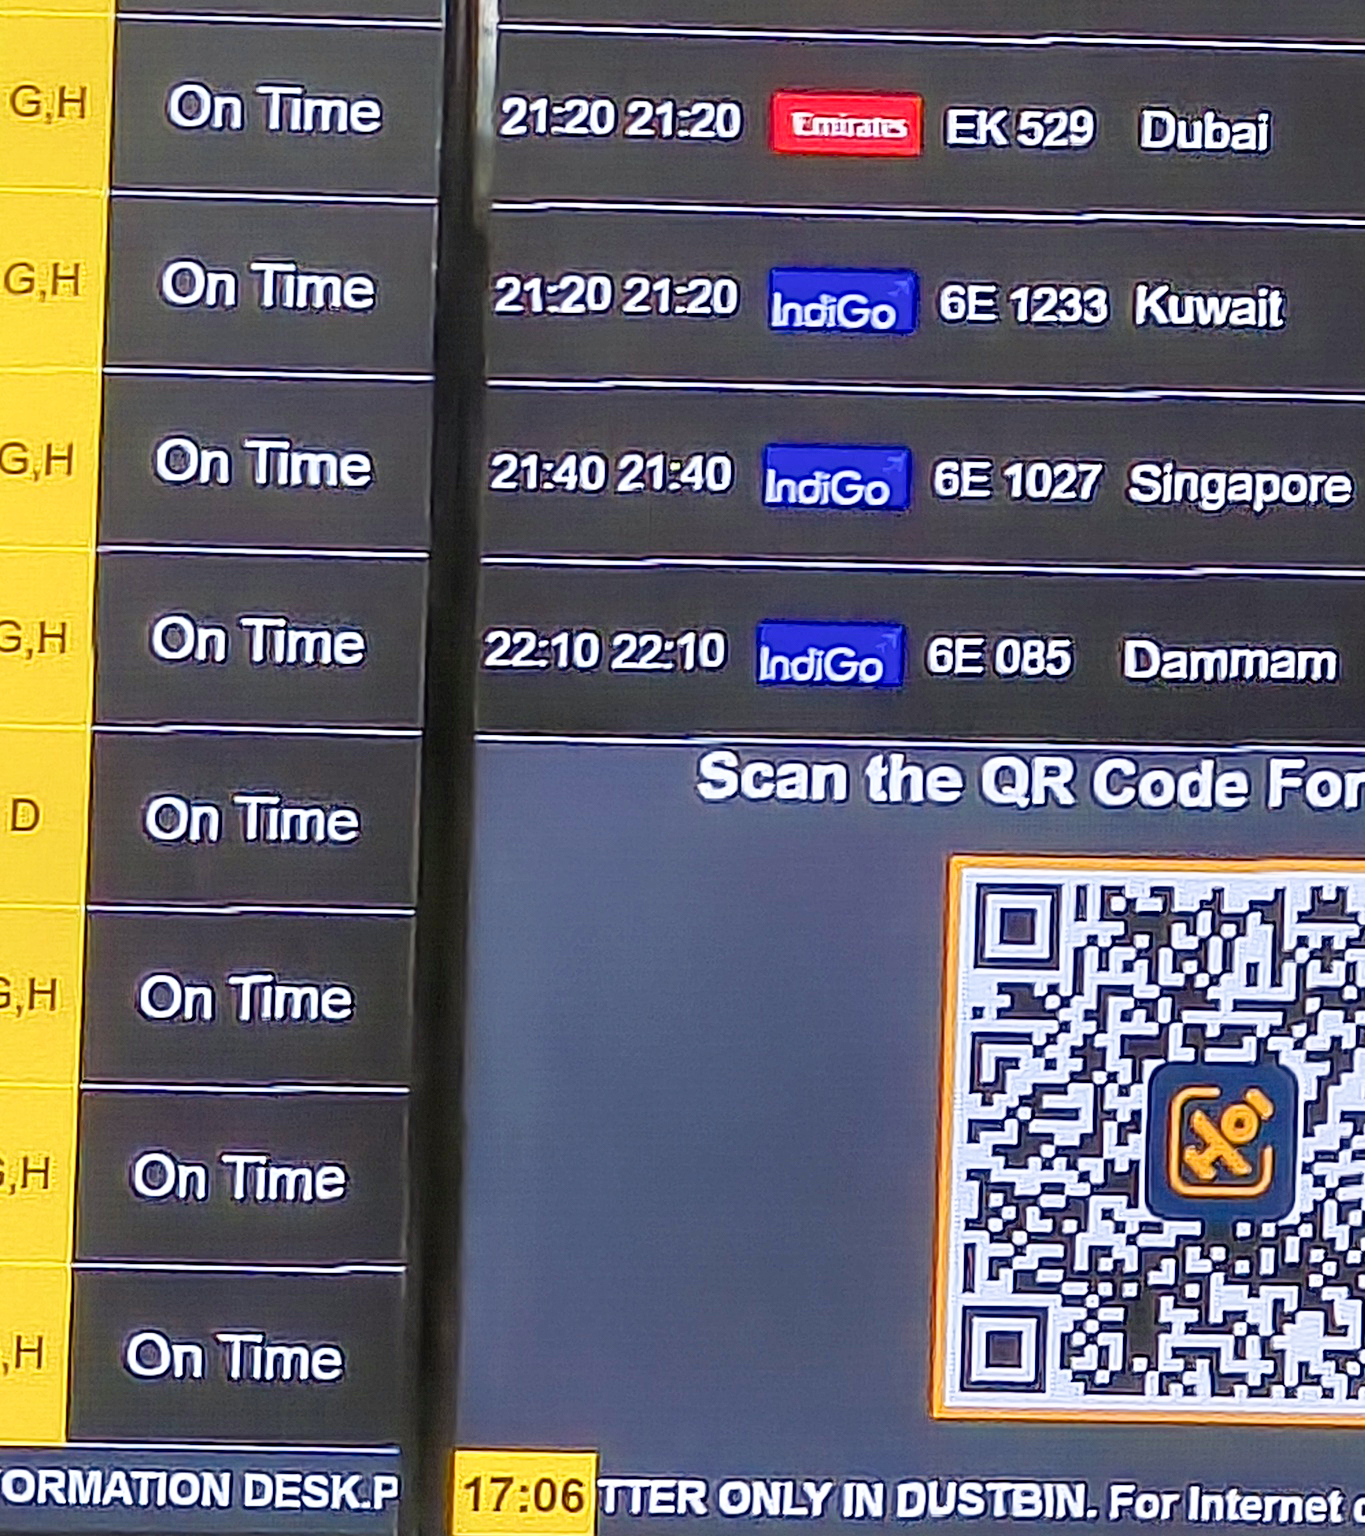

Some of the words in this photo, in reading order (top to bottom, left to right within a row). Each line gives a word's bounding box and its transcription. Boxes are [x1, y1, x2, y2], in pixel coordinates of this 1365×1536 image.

[9, 84, 87, 121] G,H
[170, 84, 242, 129] On
[255, 86, 381, 133] Time
[500, 97, 615, 135] 21:20
[624, 100, 741, 138] 21:20
[790, 111, 908, 138] Emirates
[946, 109, 1009, 146] EK
[1016, 109, 1094, 147] 529
[1140, 109, 1269, 151] Dubai
[3, 261, 81, 300] G,H
[494, 275, 612, 314] 21:20
[622, 276, 738, 314] 21:20
[771, 291, 897, 330] IndiGo
[940, 284, 998, 321] 6E
[1009, 286, 1108, 324] 1233
[1135, 284, 1284, 327] Kuwait
[156, 438, 229, 484] On
[243, 438, 371, 487] Time
[490, 453, 606, 491] 21:40
[617, 454, 732, 492] 21:40
[764, 468, 891, 506] IndiGo
[934, 461, 992, 497] 6E
[1003, 462, 1103, 500] 1027
[1128, 462, 1352, 512] Singapore
[484, 630, 600, 668] 22:10
[610, 631, 725, 671] 22:10
[759, 645, 884, 684] IndiGo
[927, 637, 985, 674] 6E
[995, 638, 1072, 676] 085
[1124, 639, 1337, 681] Dammam
[697, 750, 849, 802] Scan
[865, 753, 965, 804] the
[981, 756, 1077, 808] QR
[1092, 757, 1250, 809] Code
[10, 797, 40, 832] D
[1, 1469, 231, 1507] ORMATION
[464, 1475, 585, 1514] 17:06
[718, 1480, 834, 1517] ONLY
[842, 1482, 884, 1518] IN
[896, 1477, 1098, 1519] DUSTBIN.
[1109, 1484, 1181, 1520] For
[1188, 1485, 1344, 1523] Internet
